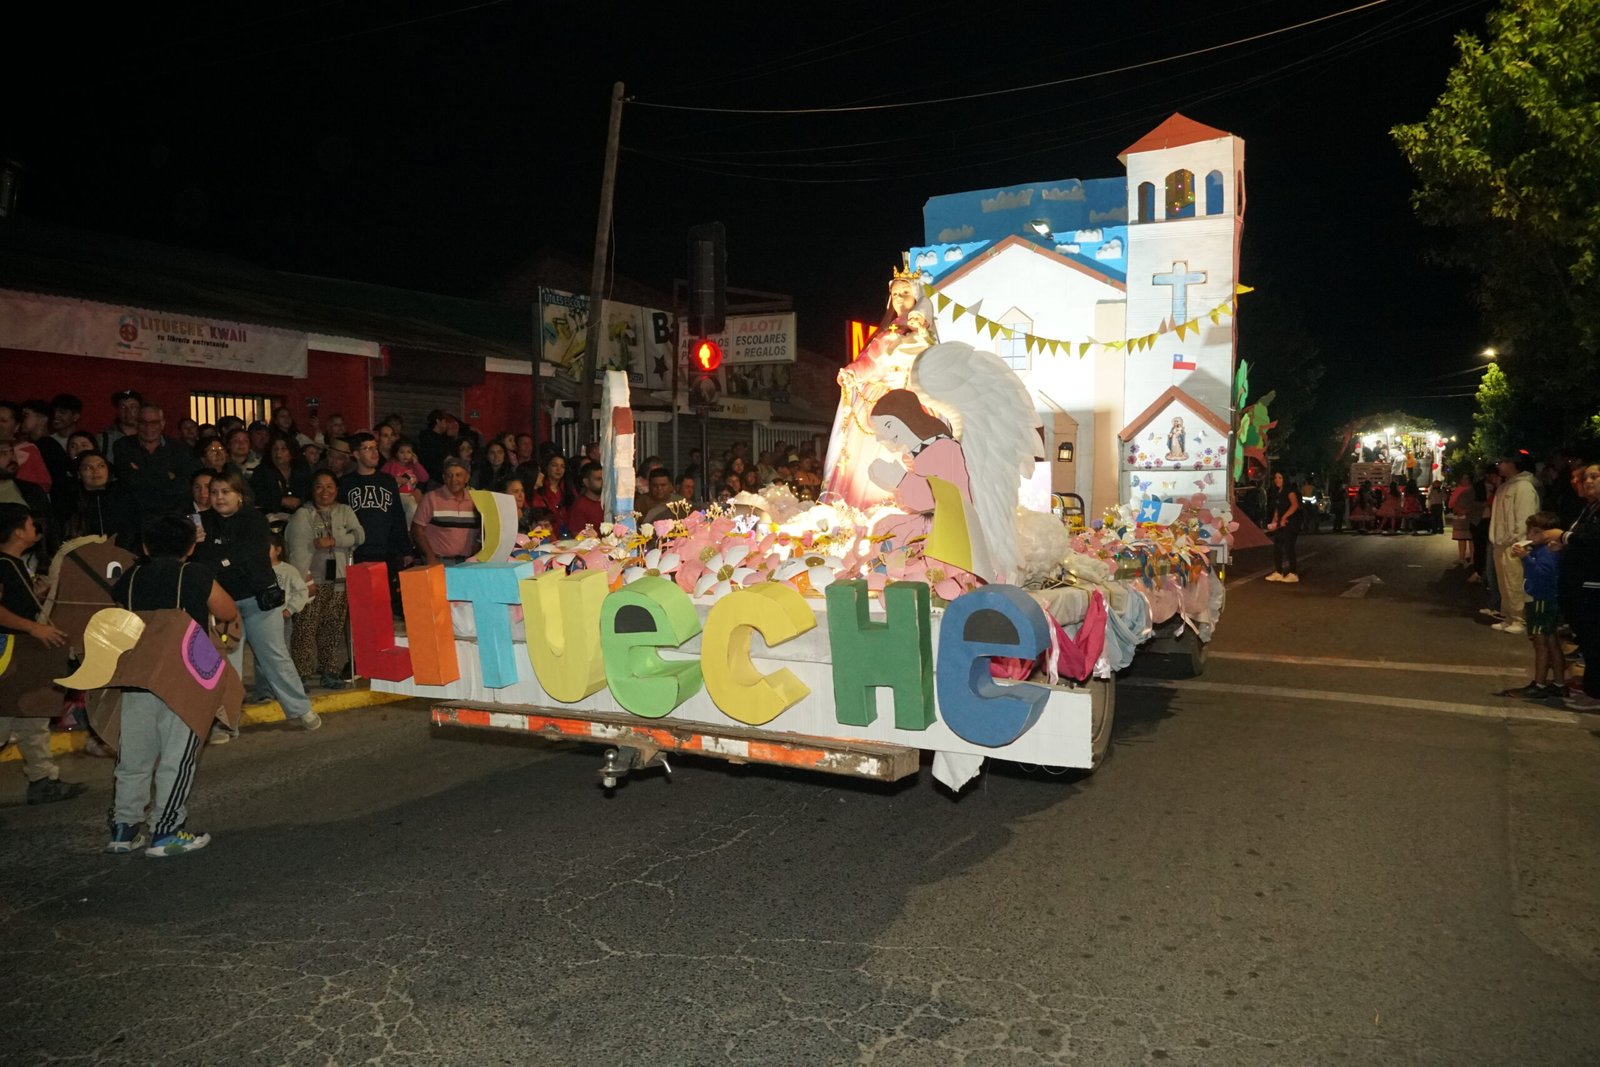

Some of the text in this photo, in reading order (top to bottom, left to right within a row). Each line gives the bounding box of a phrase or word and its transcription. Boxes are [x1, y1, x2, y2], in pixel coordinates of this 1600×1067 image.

[141, 317, 204, 338] LITUECHE
[736, 333, 787, 346] ESCOLARES
[744, 345, 786, 358] REGALOS
[348, 485, 393, 512] GAP
